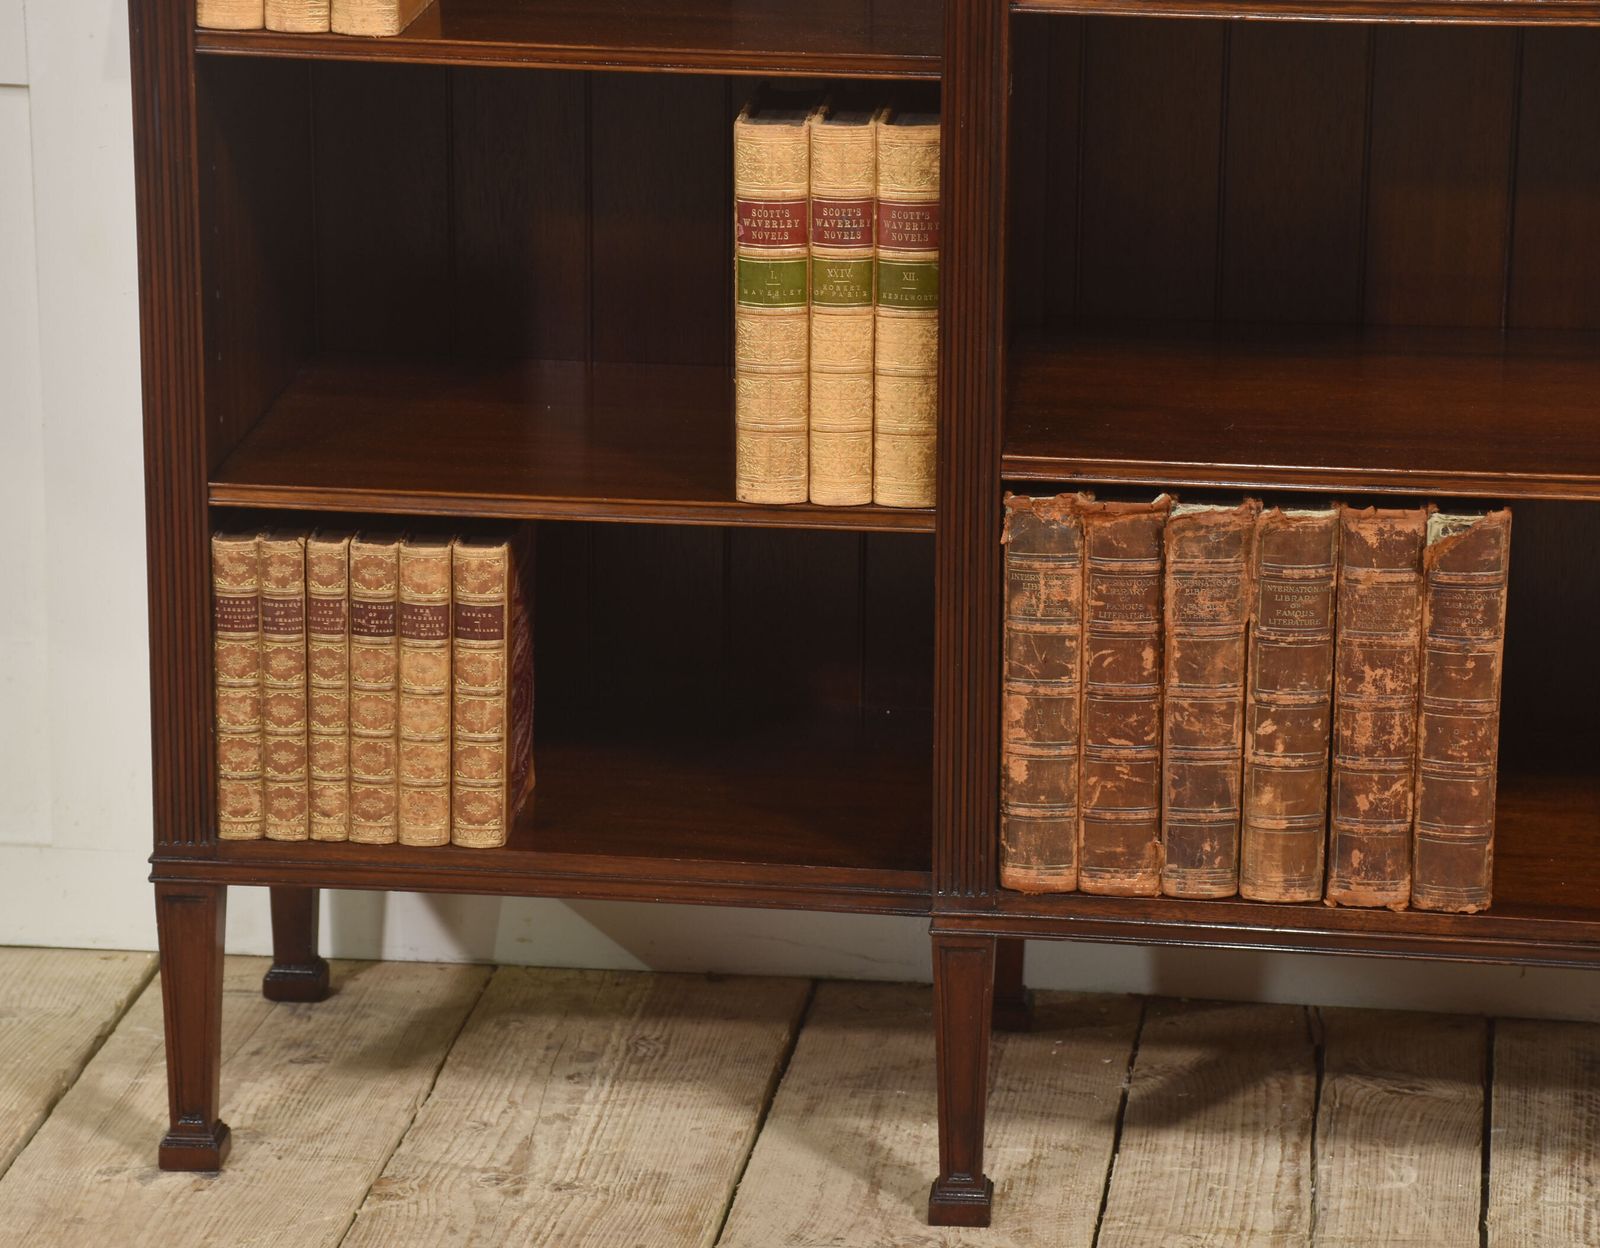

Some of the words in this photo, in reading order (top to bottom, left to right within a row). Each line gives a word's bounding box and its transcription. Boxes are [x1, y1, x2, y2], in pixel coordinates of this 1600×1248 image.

[751, 208, 791, 218] SCOTT'S
[822, 207, 862, 217] SCOTT'S
[891, 210, 931, 221] SCOTT'S
[743, 217, 801, 228] WAVERLEY
[815, 218, 871, 228] WAVERLEY
[883, 220, 940, 232] WAVERLEY
[751, 230, 790, 241] NOVELS
[823, 230, 862, 240] NOVELS
[891, 232, 929, 242] NOVELS
[1276, 609, 1315, 617] FAMOUS
[1268, 618, 1321, 626] LITERATURE
